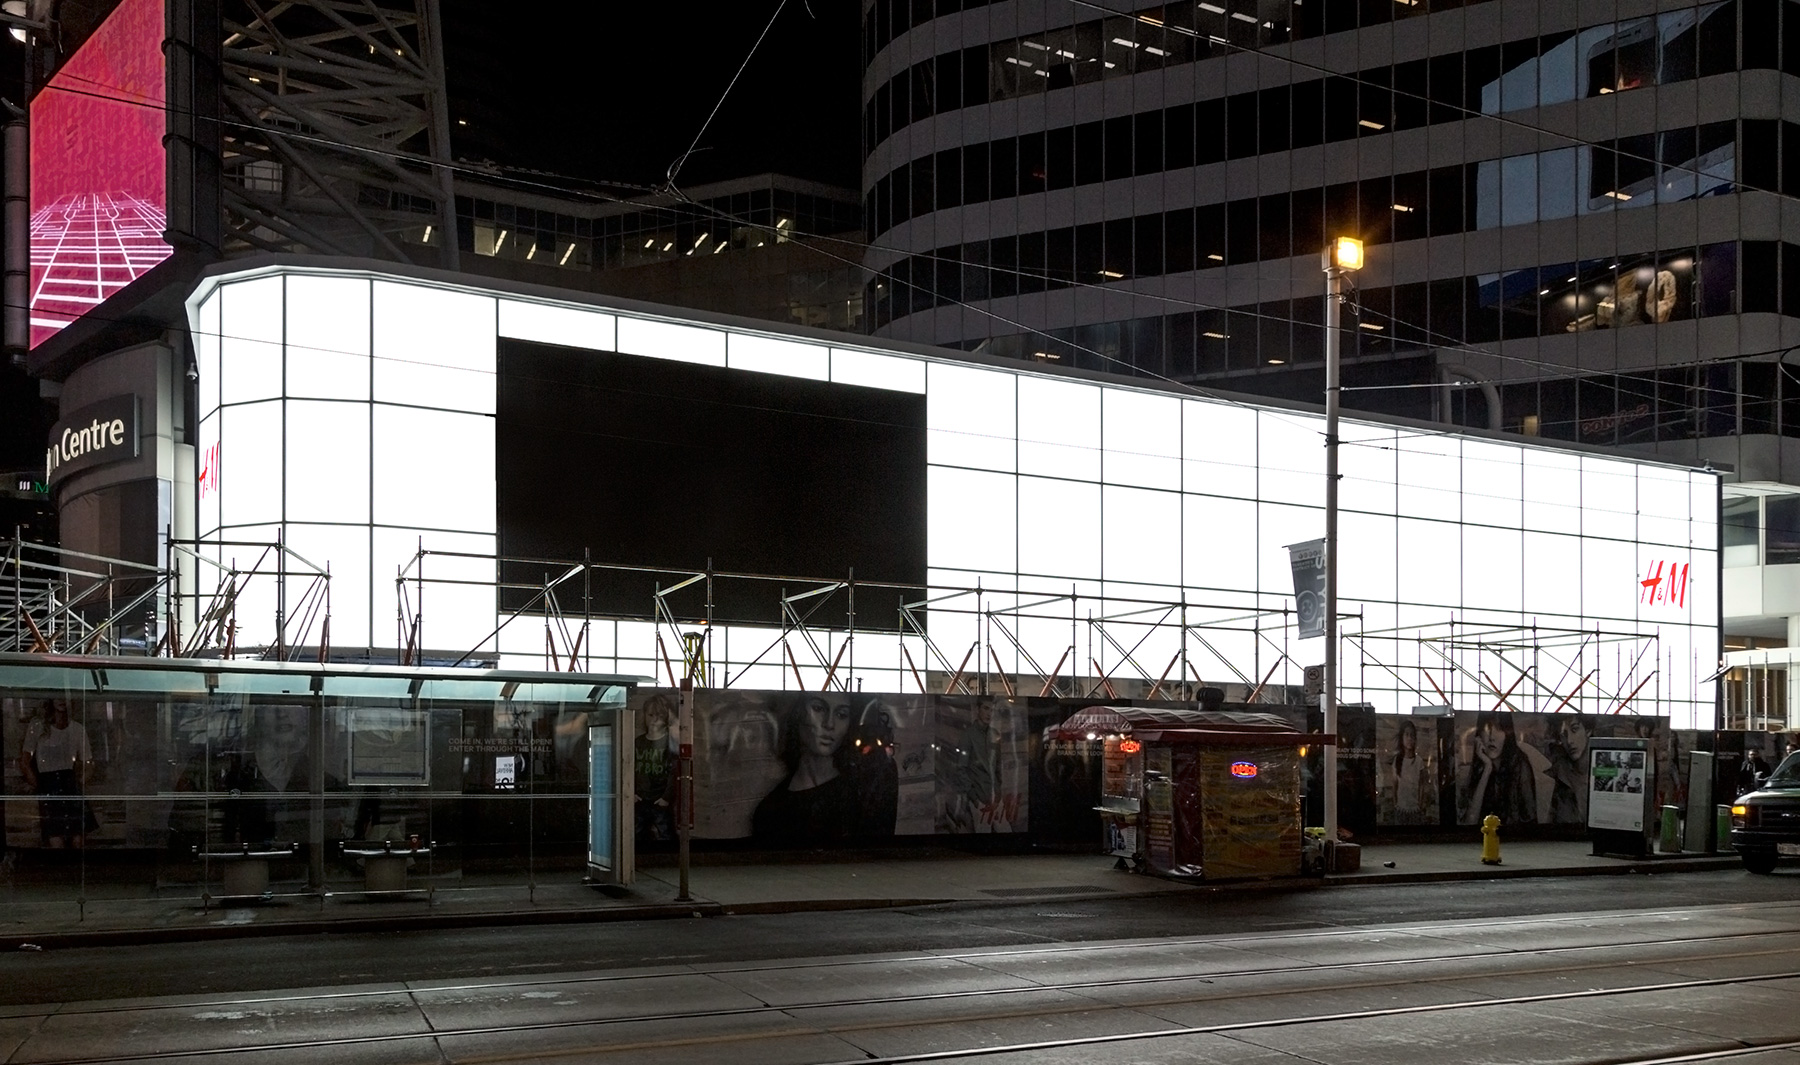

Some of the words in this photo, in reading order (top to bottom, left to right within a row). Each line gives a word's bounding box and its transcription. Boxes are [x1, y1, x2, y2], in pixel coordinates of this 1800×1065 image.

[61, 419, 125, 462] Centre
[1640, 559, 1690, 609] H&M
[448, 737, 472, 745] COME
[509, 737, 529, 745] STILL
[448, 745, 474, 753] ENTER
[476, 745, 513, 753] THROUGH
[514, 745, 529, 753] THE
